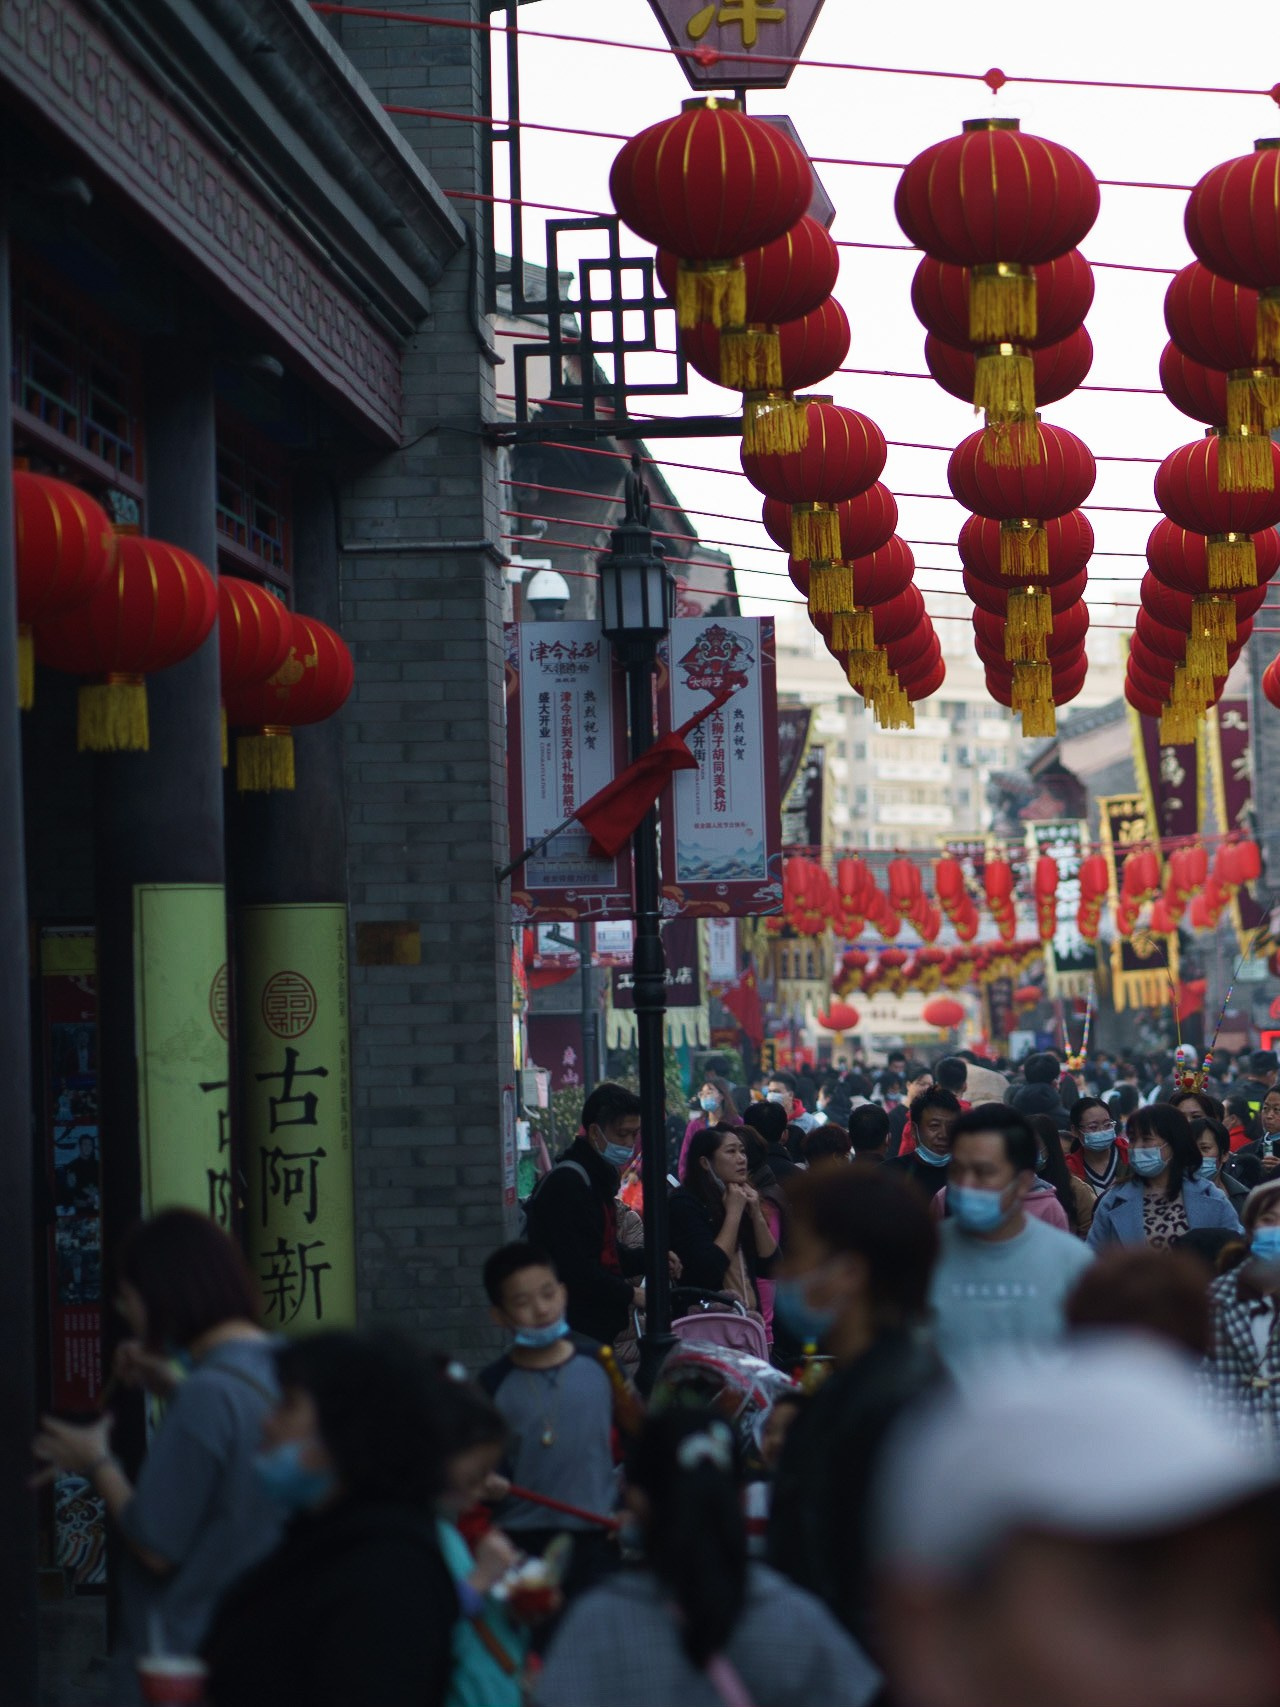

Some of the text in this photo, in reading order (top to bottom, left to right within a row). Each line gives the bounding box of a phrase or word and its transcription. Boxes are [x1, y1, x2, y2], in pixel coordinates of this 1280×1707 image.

[537, 691, 551, 738] 盛大开业
[560, 691, 575, 818] 津今乐到天津礼物旗舰店
[584, 690, 598, 750] 热烈祝贺
[733, 708, 747, 760] 热烈祝贺
[711, 709, 726, 812] 大狮子胡同美食坊
[255, 1046, 332, 1325] 古阿新
